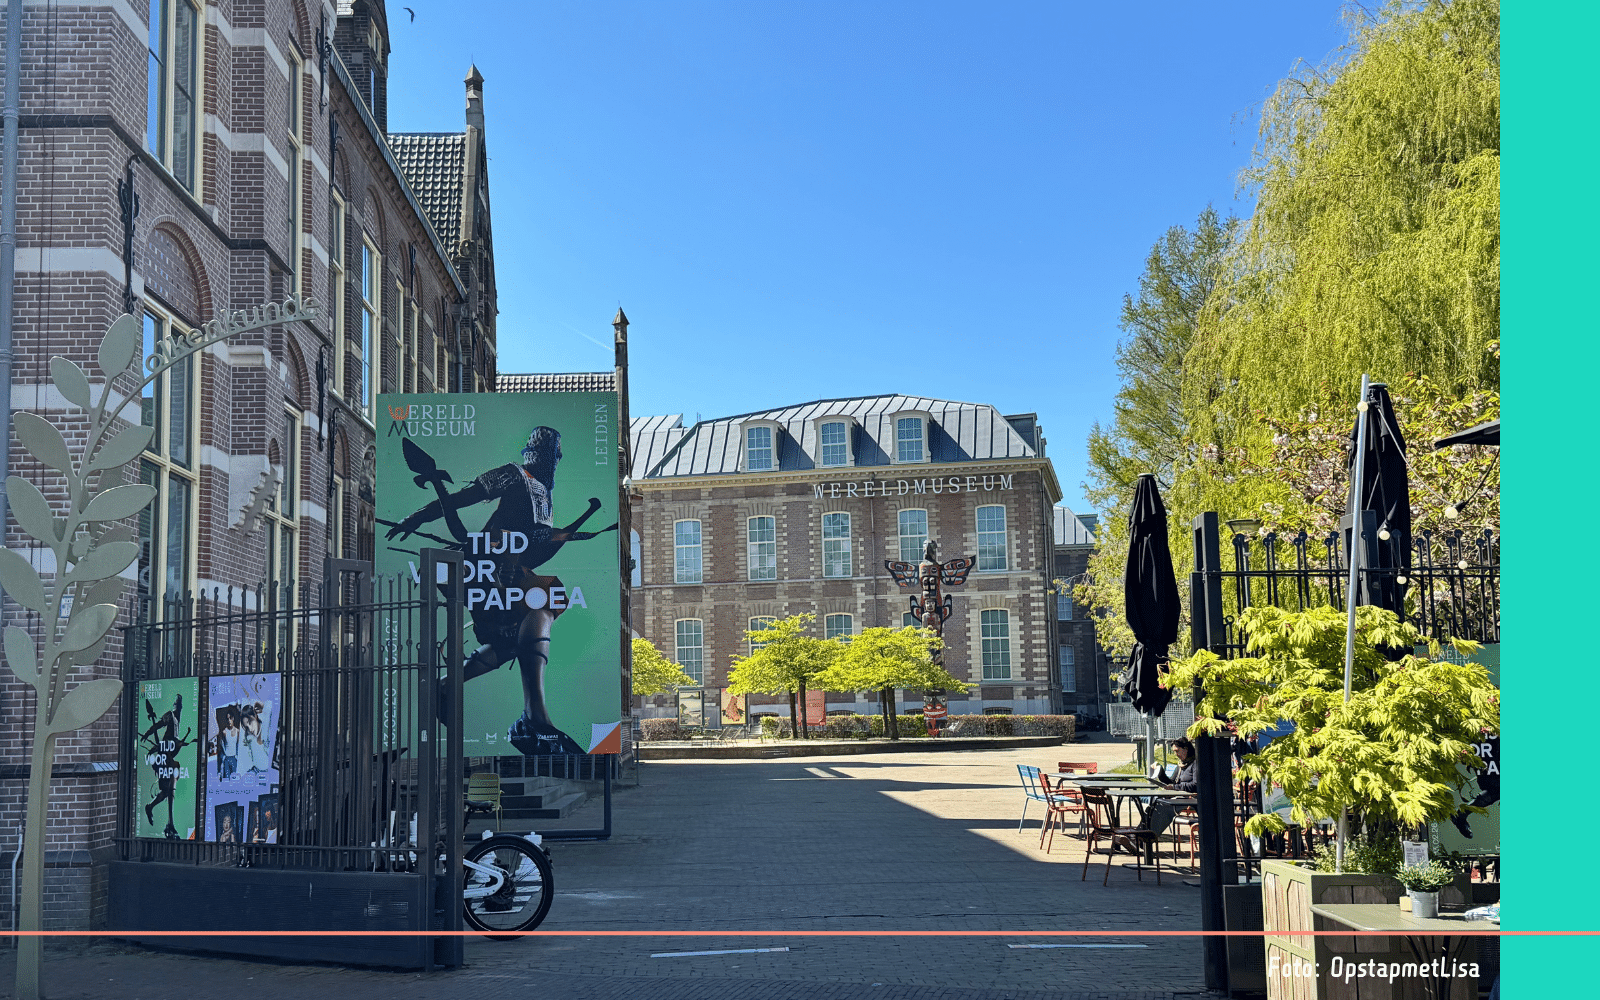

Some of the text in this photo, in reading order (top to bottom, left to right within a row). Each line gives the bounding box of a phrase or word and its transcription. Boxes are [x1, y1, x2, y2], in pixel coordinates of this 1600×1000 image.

[388, 404, 476, 420] WERELD
[388, 421, 476, 437] MUSEUM
[595, 403, 608, 466] LEIDEN
[813, 474, 1014, 499] WERELDMUSEUM
[467, 531, 529, 555] TIJD
[468, 587, 588, 611] PAPOEA
[159, 740, 176, 752] TIJD
[1469, 743, 1493, 758] OR
[144, 754, 167, 766] VOOR
[158, 767, 190, 779] PAPOEA
